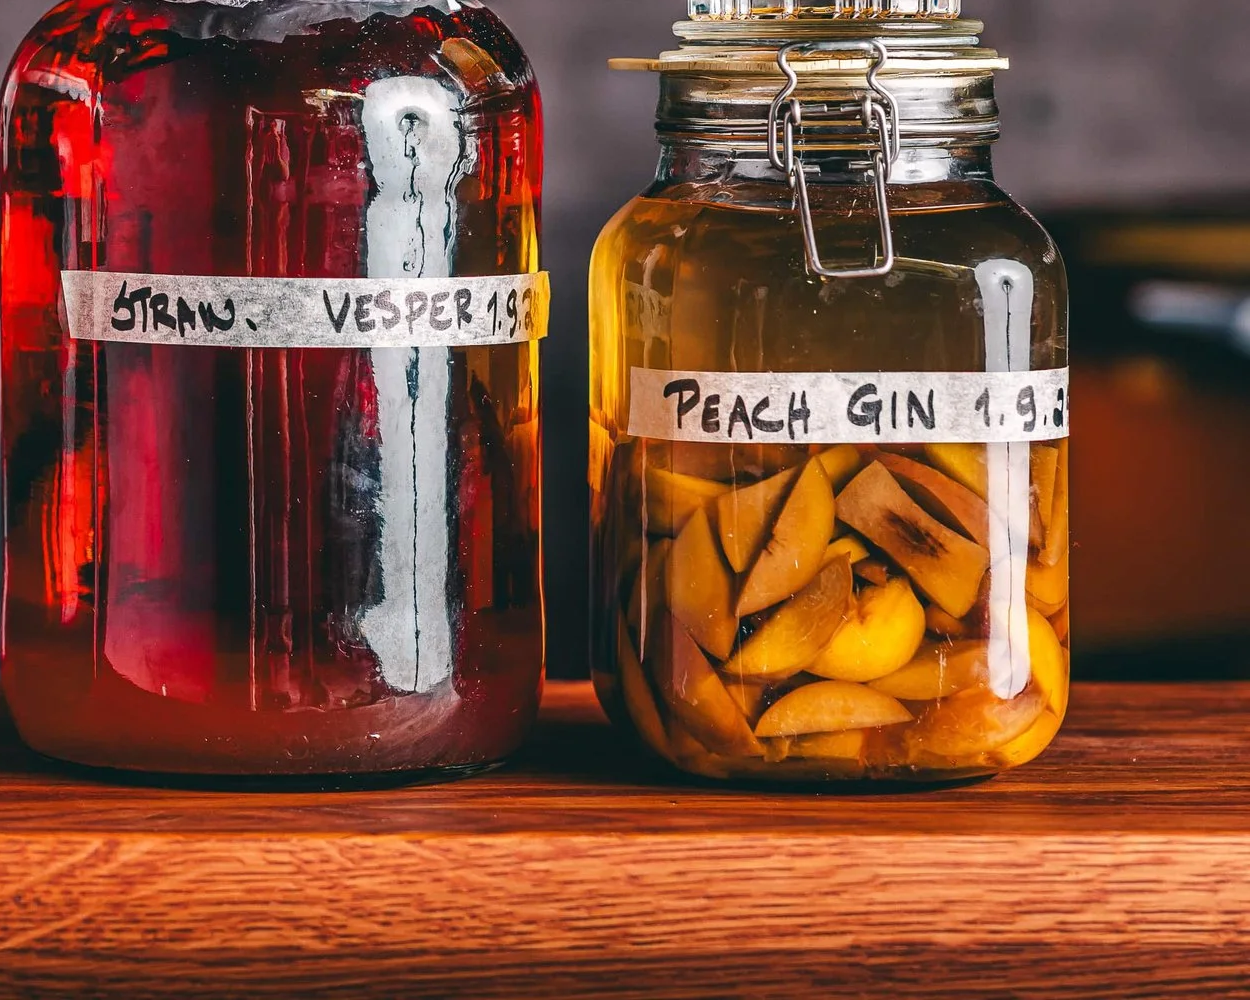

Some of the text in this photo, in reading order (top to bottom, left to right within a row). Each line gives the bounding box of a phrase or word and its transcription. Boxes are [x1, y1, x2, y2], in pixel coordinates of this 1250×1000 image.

[322, 288, 473, 334] VESPER
[663, 378, 811, 440] PEACH
[846, 382, 935, 435] GIN
